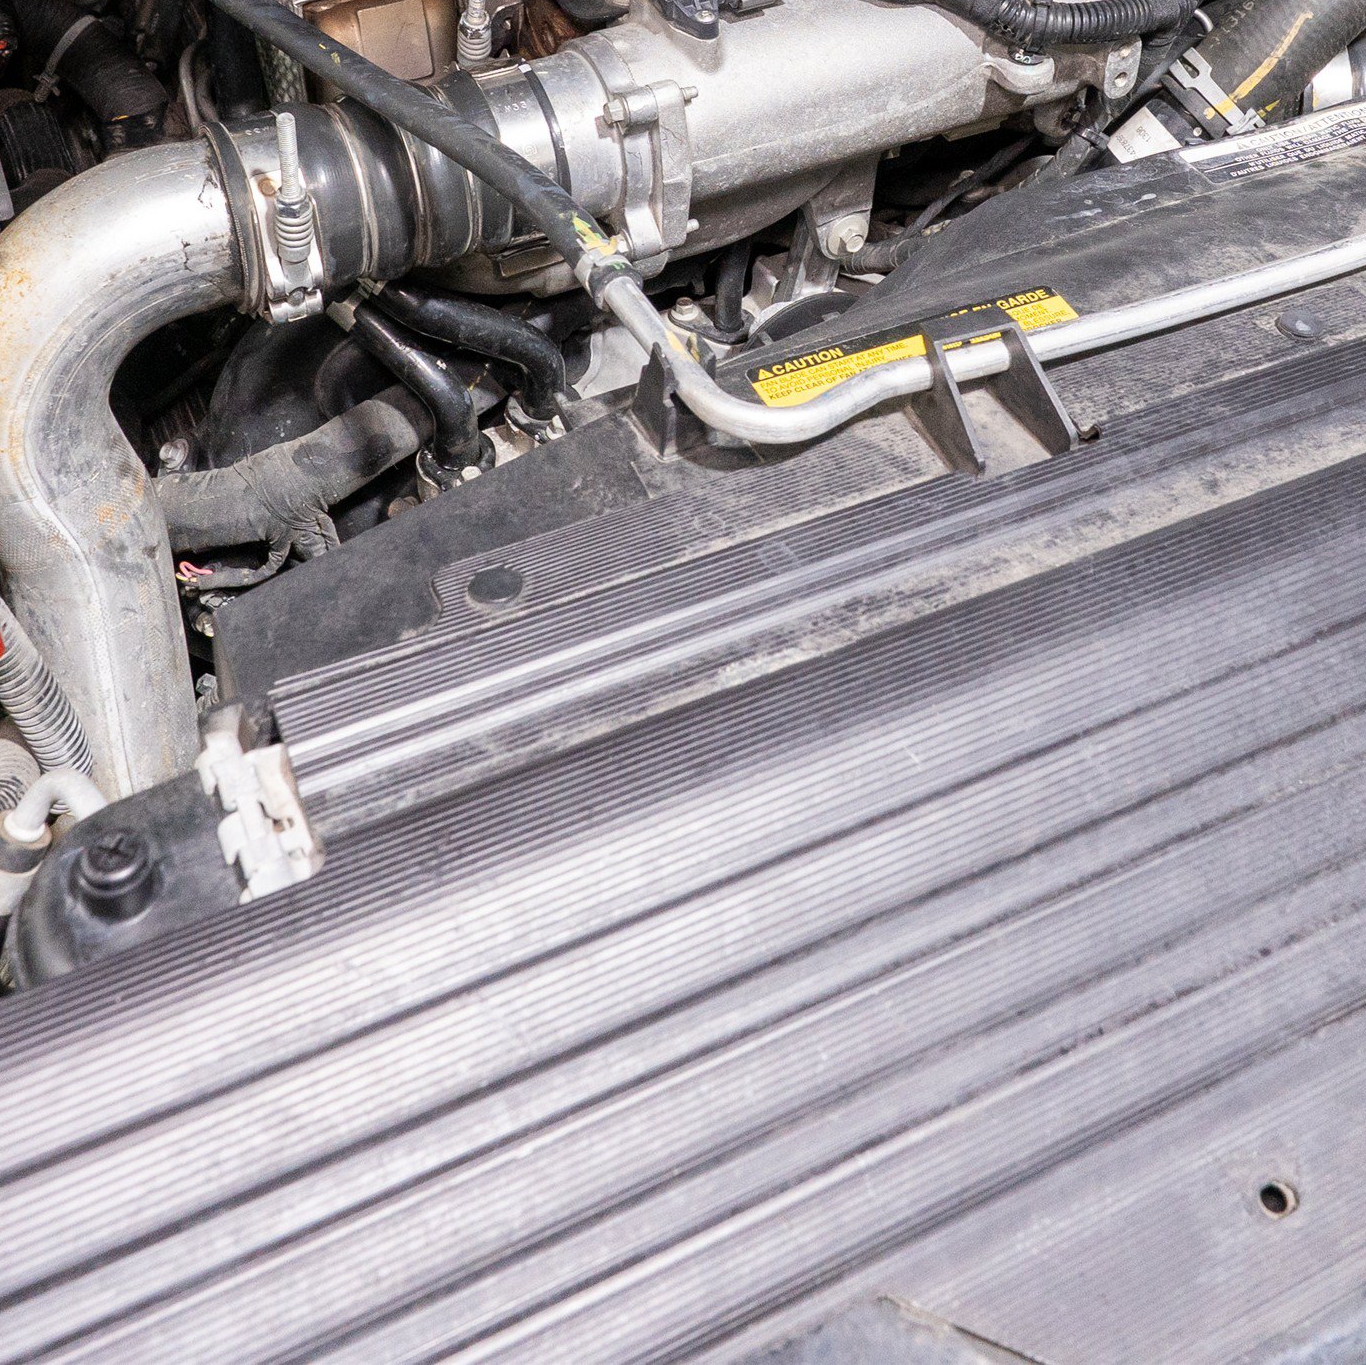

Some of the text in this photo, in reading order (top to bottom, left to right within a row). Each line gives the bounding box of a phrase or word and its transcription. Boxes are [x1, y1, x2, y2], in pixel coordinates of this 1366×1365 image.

[996, 288, 1050, 310] GARDE
[771, 347, 844, 375] CAUTION
[779, 370, 807, 383] BLADE
[808, 366, 827, 375] CAN
[827, 357, 855, 370] START
[867, 349, 885, 358] ANY
[764, 386, 778, 394] TO
[779, 377, 806, 389] AVOID
[806, 365, 853, 381] PERSONAL
[768, 389, 793, 401] KEEP
[794, 380, 825, 393] CLEAR
